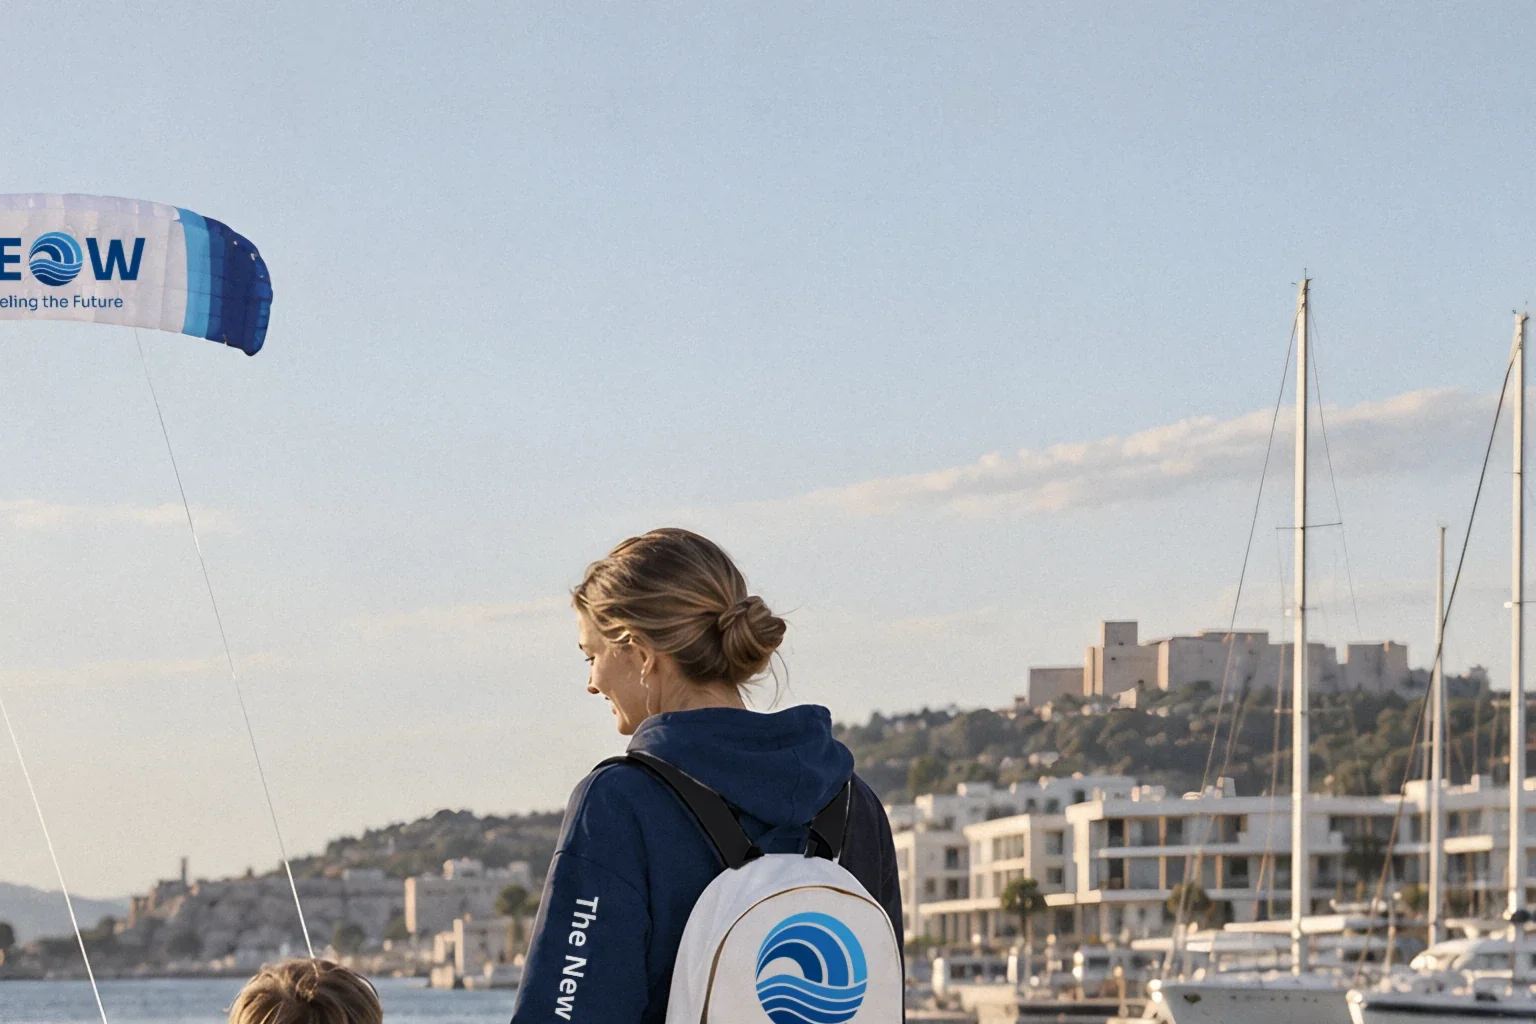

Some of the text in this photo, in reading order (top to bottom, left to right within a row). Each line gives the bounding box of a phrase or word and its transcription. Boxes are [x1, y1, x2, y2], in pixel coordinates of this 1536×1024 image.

[43, 295, 68, 308] the
[73, 295, 124, 308] Future
[568, 896, 599, 947] The
[554, 955, 587, 1020] New
